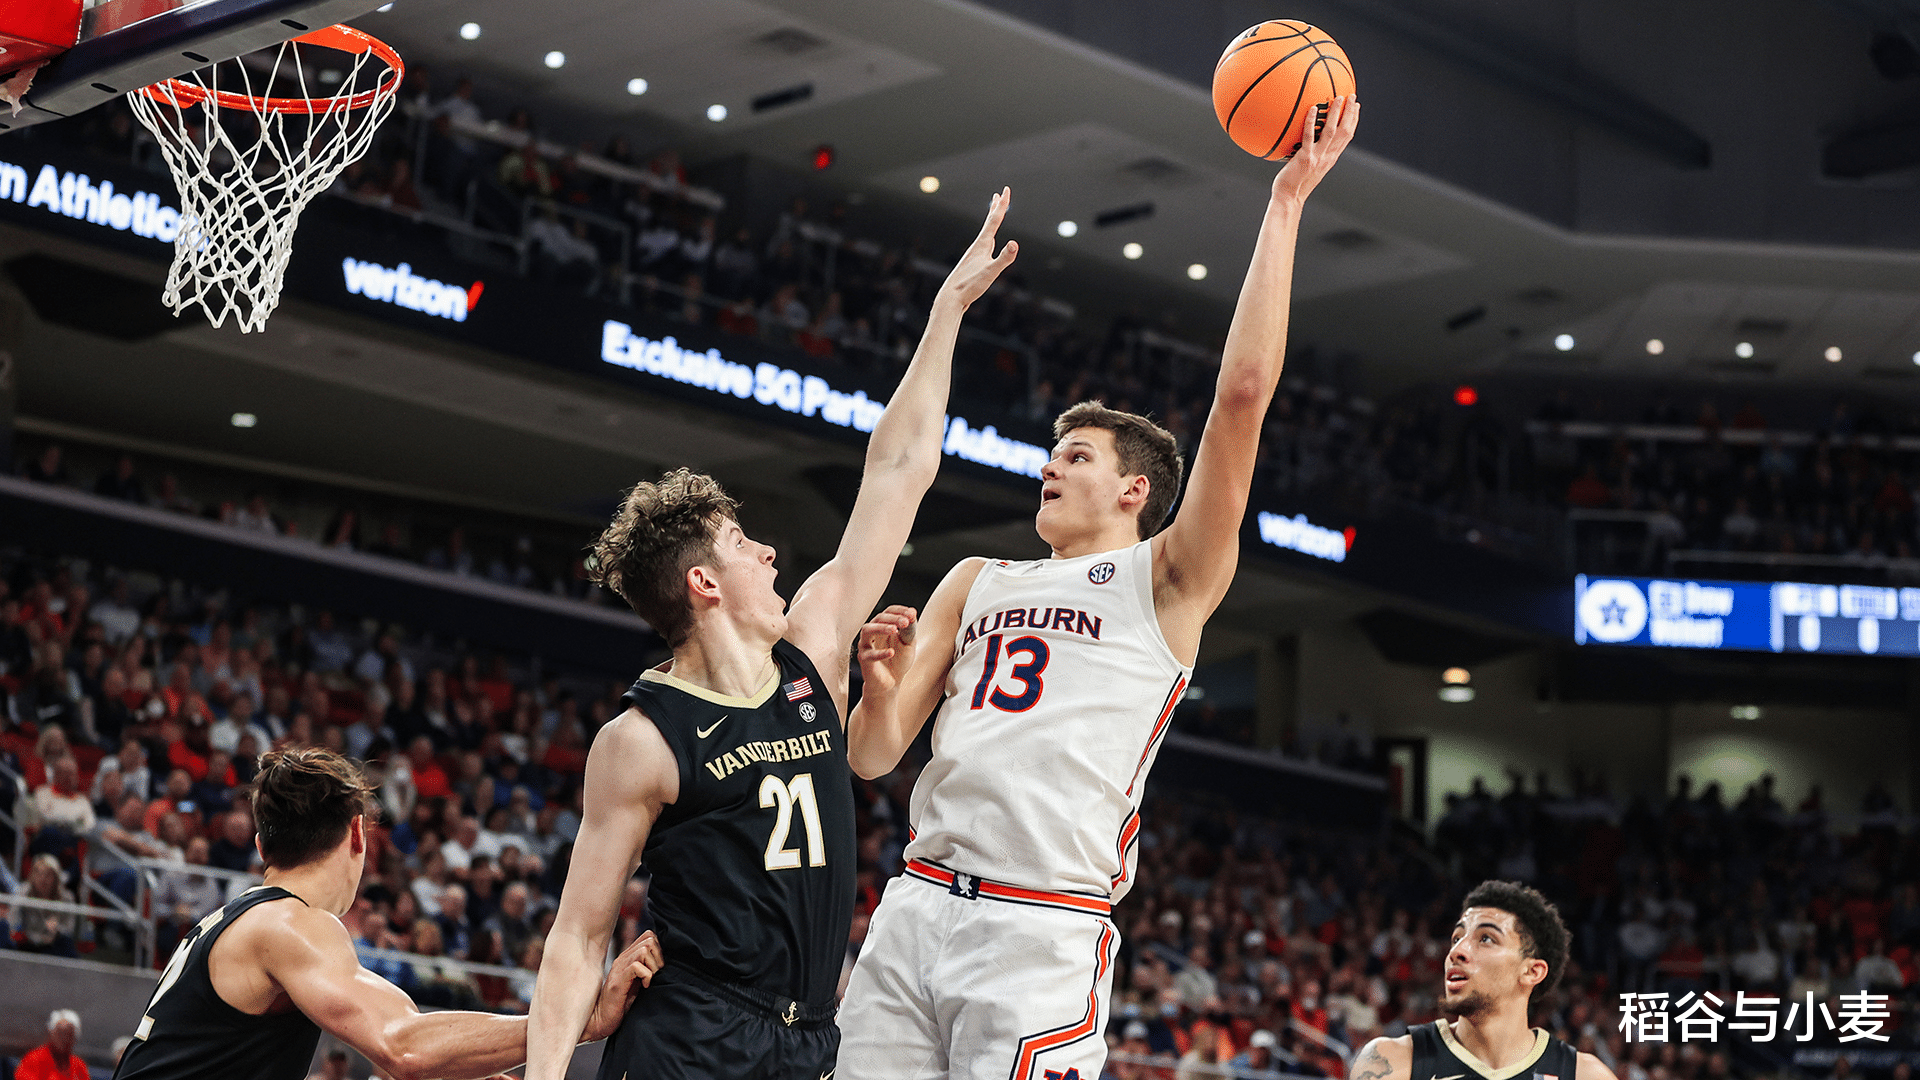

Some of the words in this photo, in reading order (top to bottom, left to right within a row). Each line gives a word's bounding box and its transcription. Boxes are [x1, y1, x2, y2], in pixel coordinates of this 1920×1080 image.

[343, 256, 468, 322] verizon
[602, 319, 754, 399] Exclusive
[753, 362, 802, 413] 5G
[801, 374, 885, 433] Partn
[1258, 511, 1347, 563] verizon
[1089, 563, 1114, 584] SEC
[961, 608, 1102, 656] AUBURN
[970, 633, 1050, 713] 13
[799, 702, 816, 722] SEC
[705, 729, 832, 781] VANDERBILT
[758, 773, 826, 871] 21
